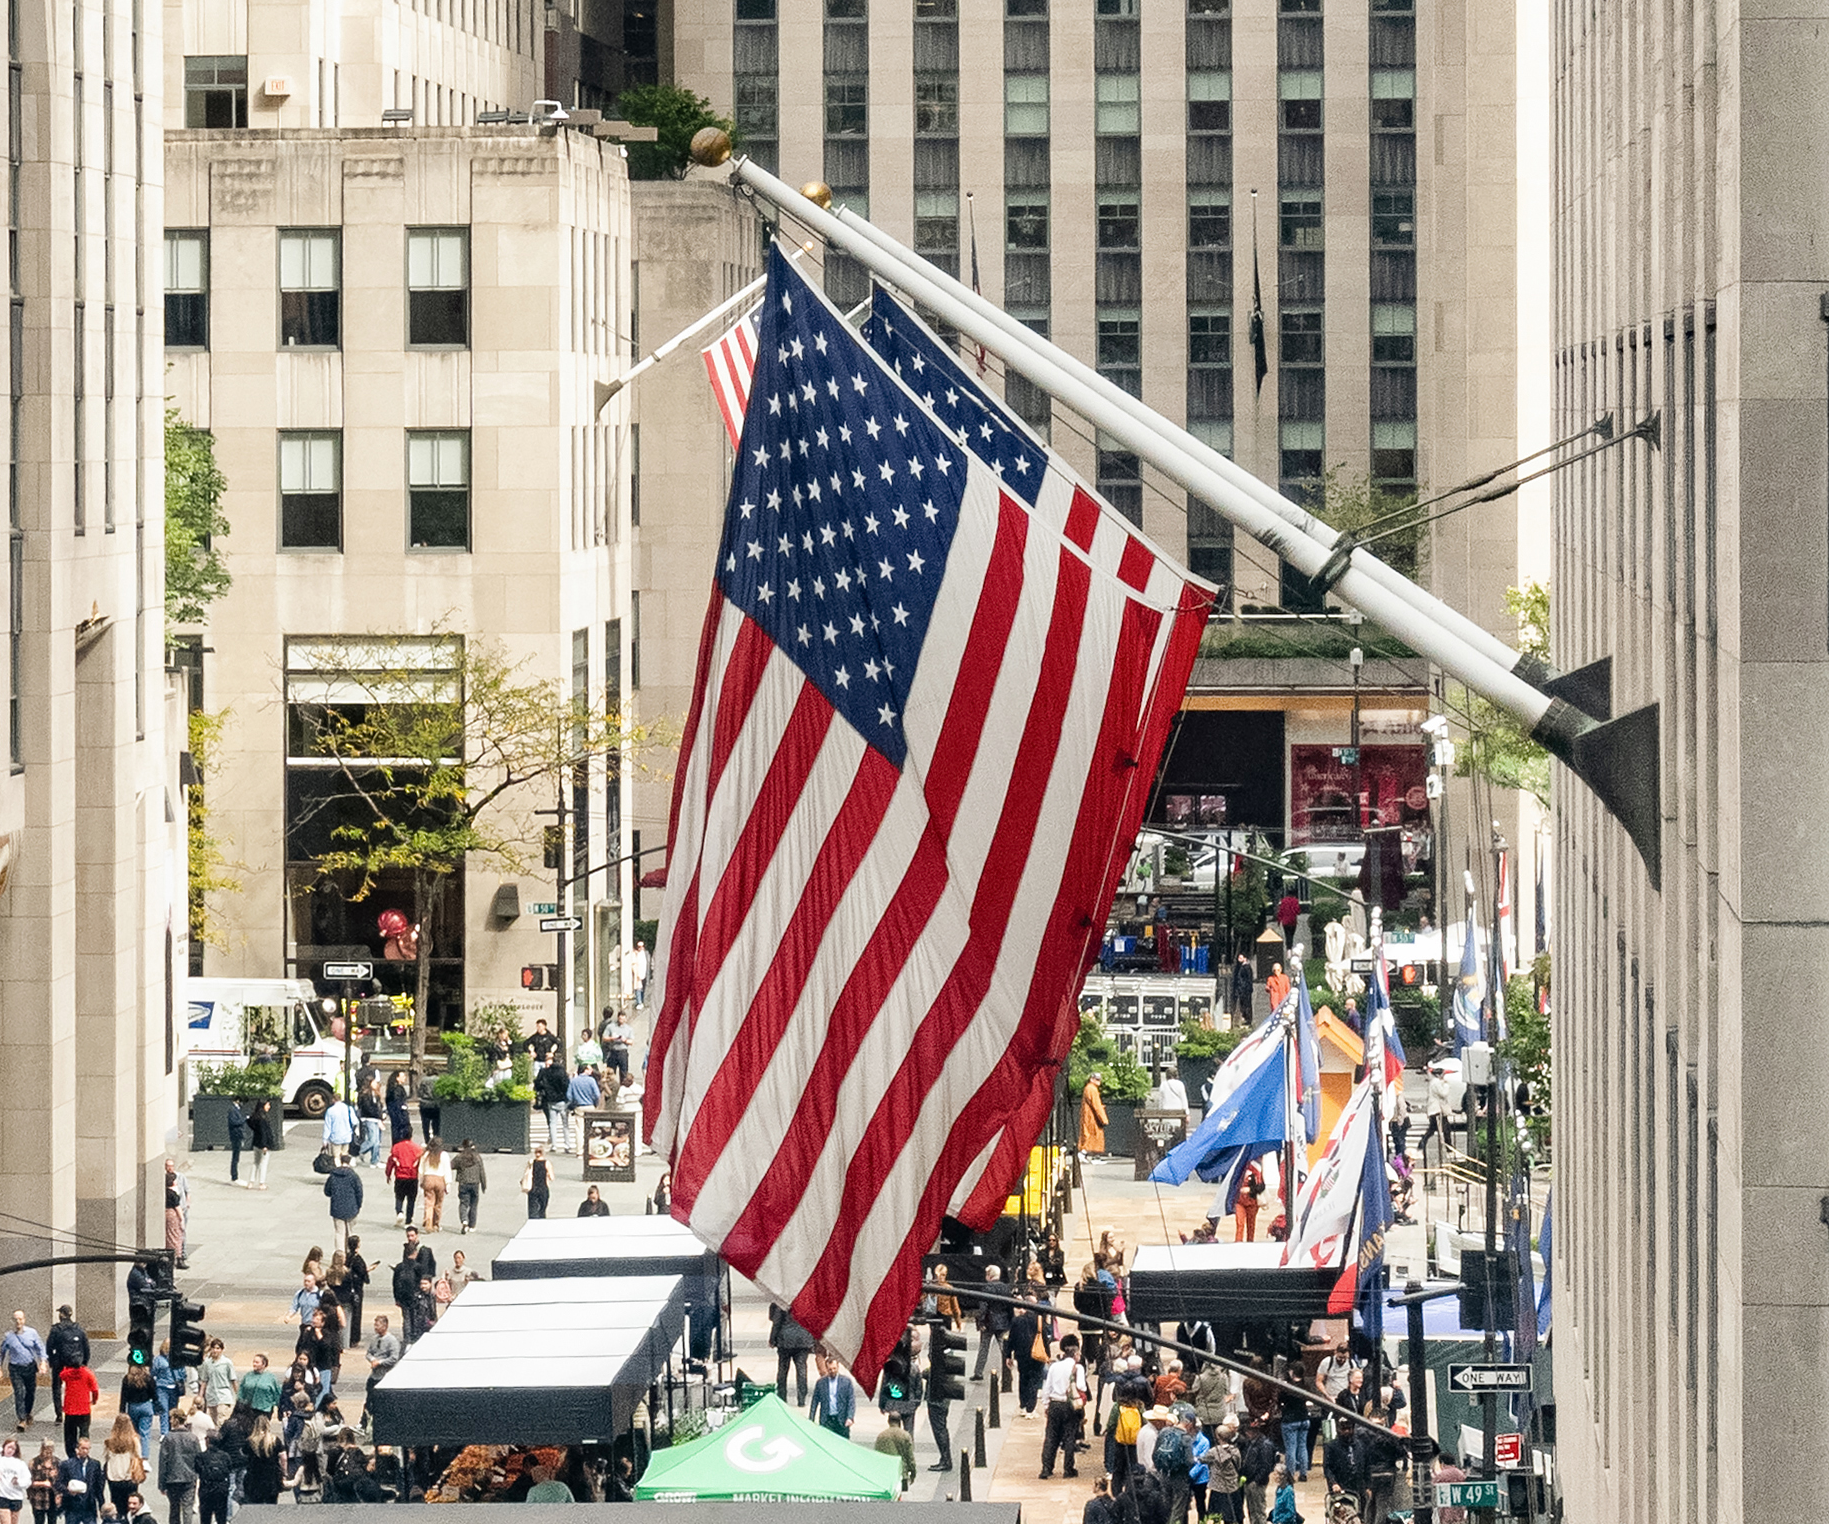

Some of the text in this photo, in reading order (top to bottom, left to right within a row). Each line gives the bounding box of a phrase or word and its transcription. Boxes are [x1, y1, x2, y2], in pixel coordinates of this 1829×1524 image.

[1462, 1372, 1521, 1383] ONE WAY
[1451, 1487, 1462, 1503] W
[1466, 1486, 1483, 1504] 49
[1485, 1485, 1495, 1495] St
